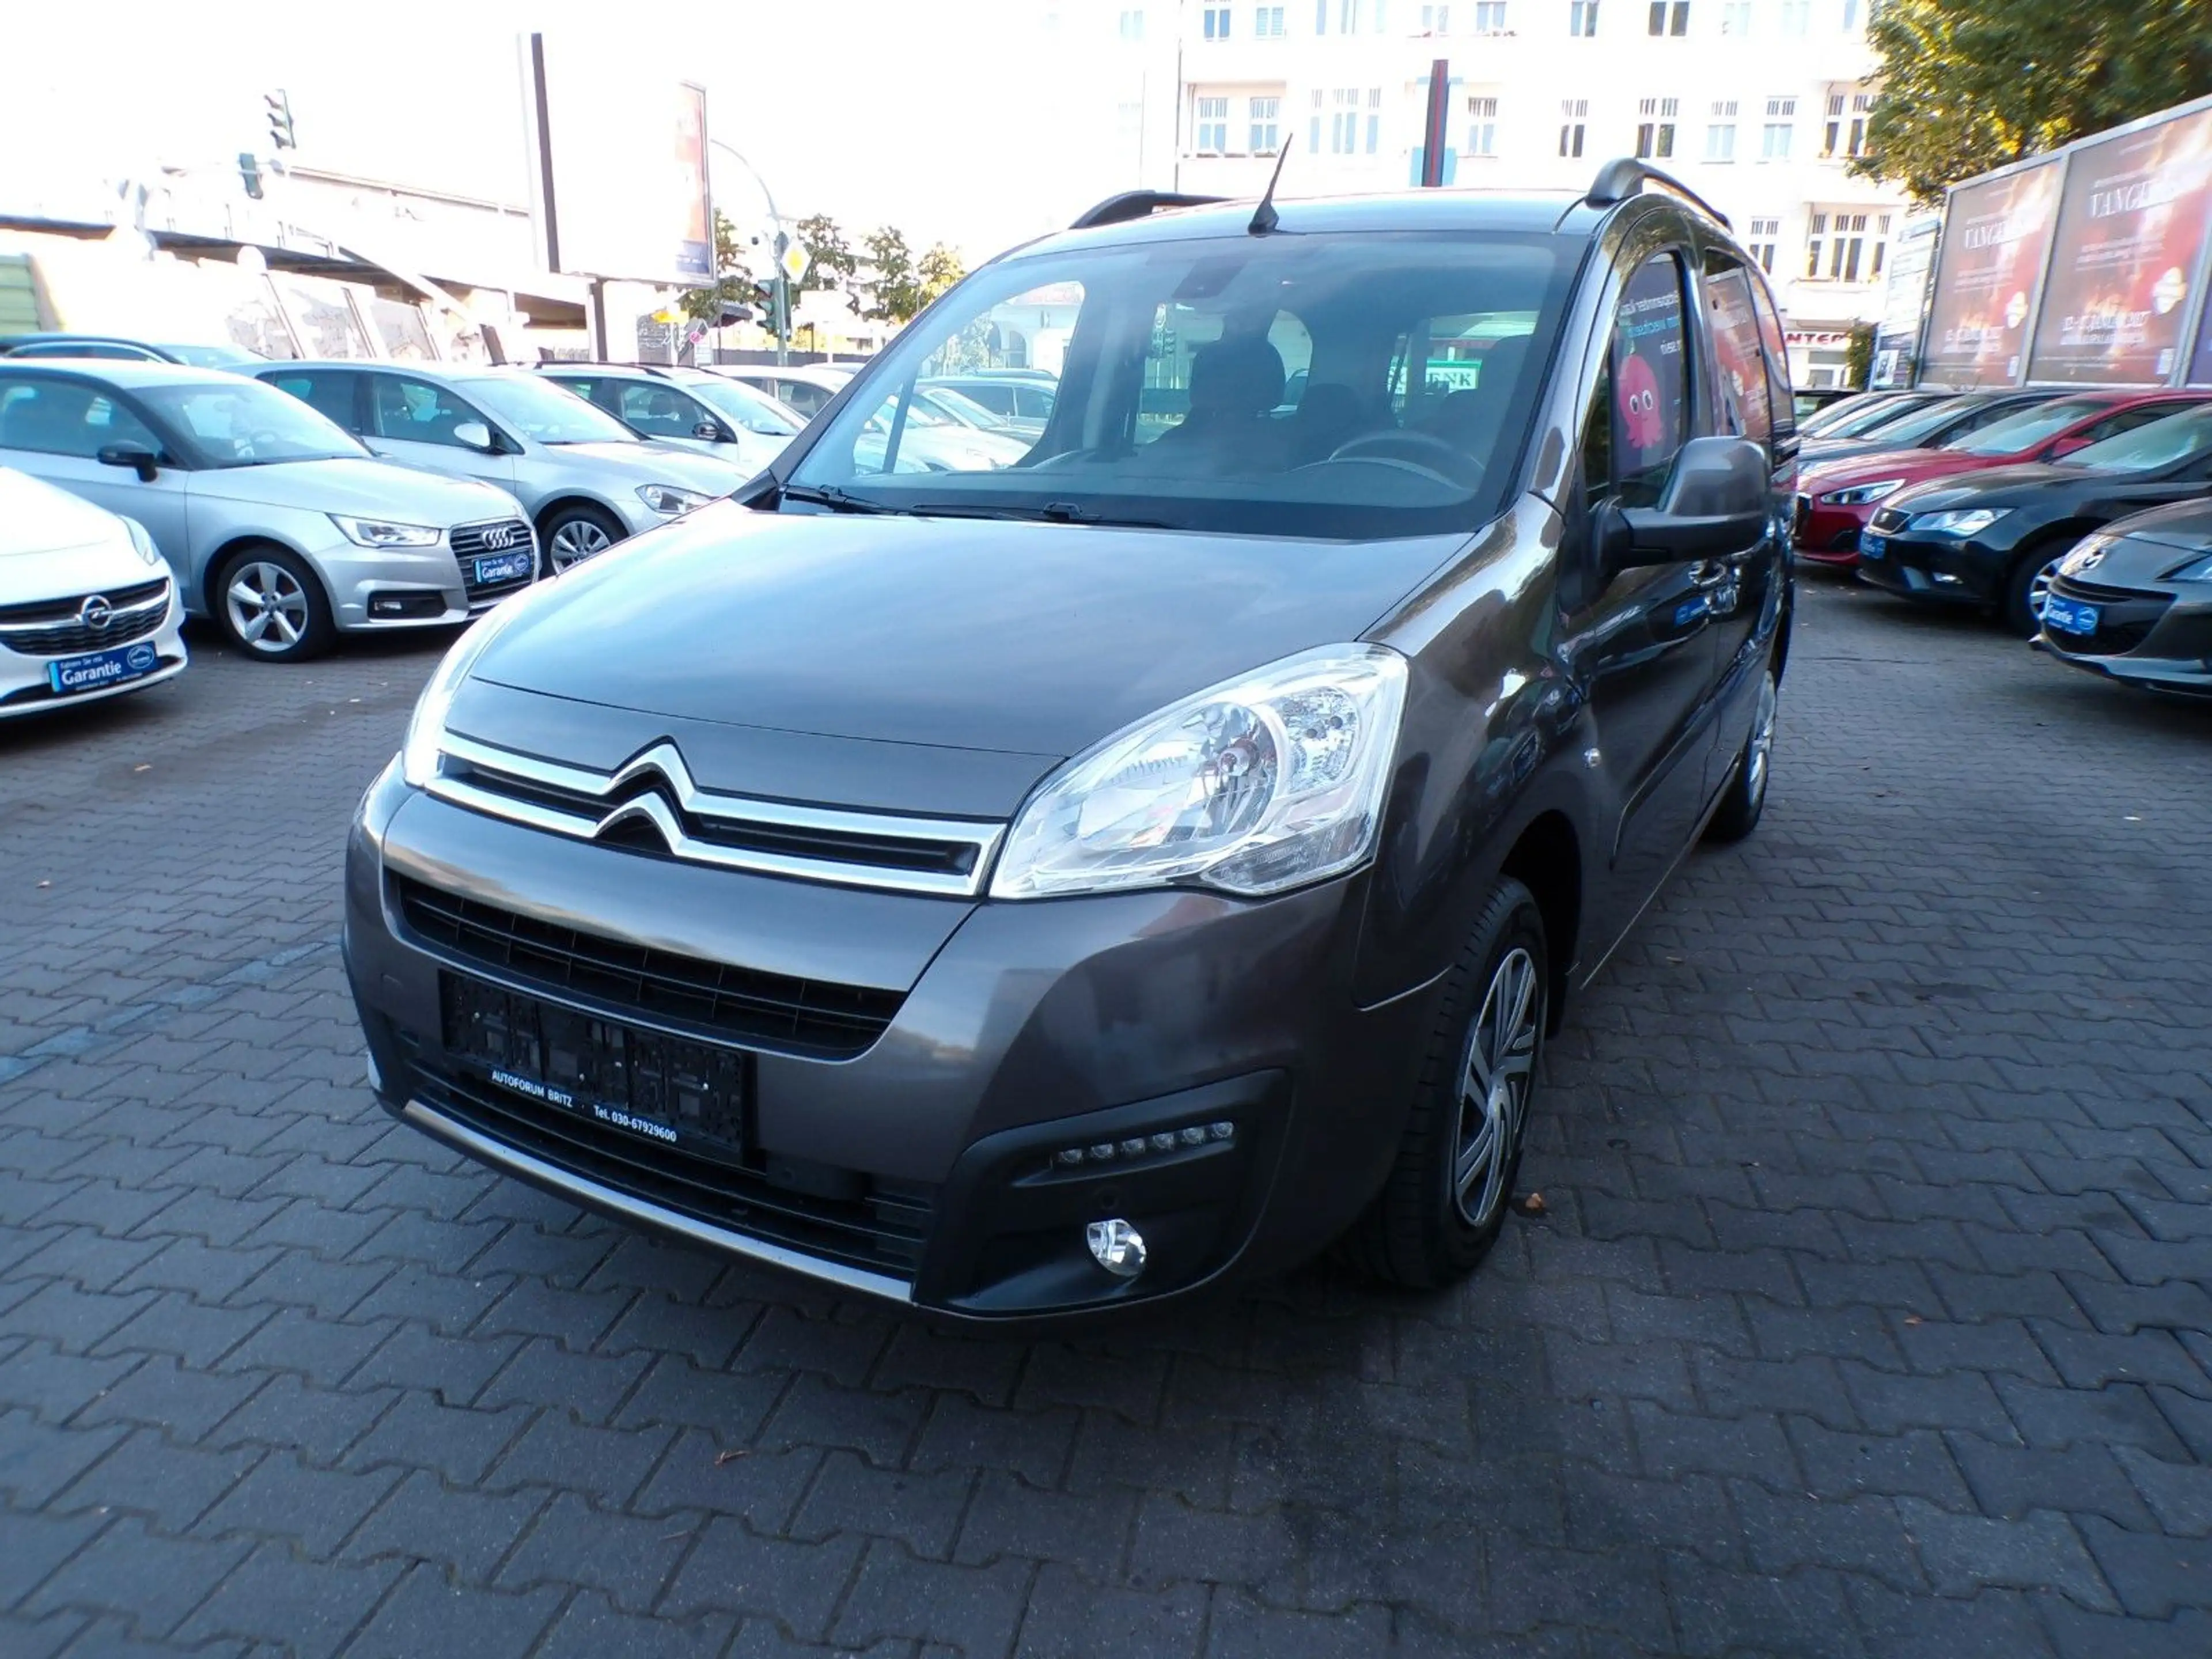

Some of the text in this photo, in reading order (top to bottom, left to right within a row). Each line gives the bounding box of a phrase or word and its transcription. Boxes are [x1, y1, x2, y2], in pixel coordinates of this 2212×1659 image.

[62, 661, 122, 685] Garantie
[492, 1070, 677, 1142] AUTOFORUM BRITZ Tel. 030-67929600
